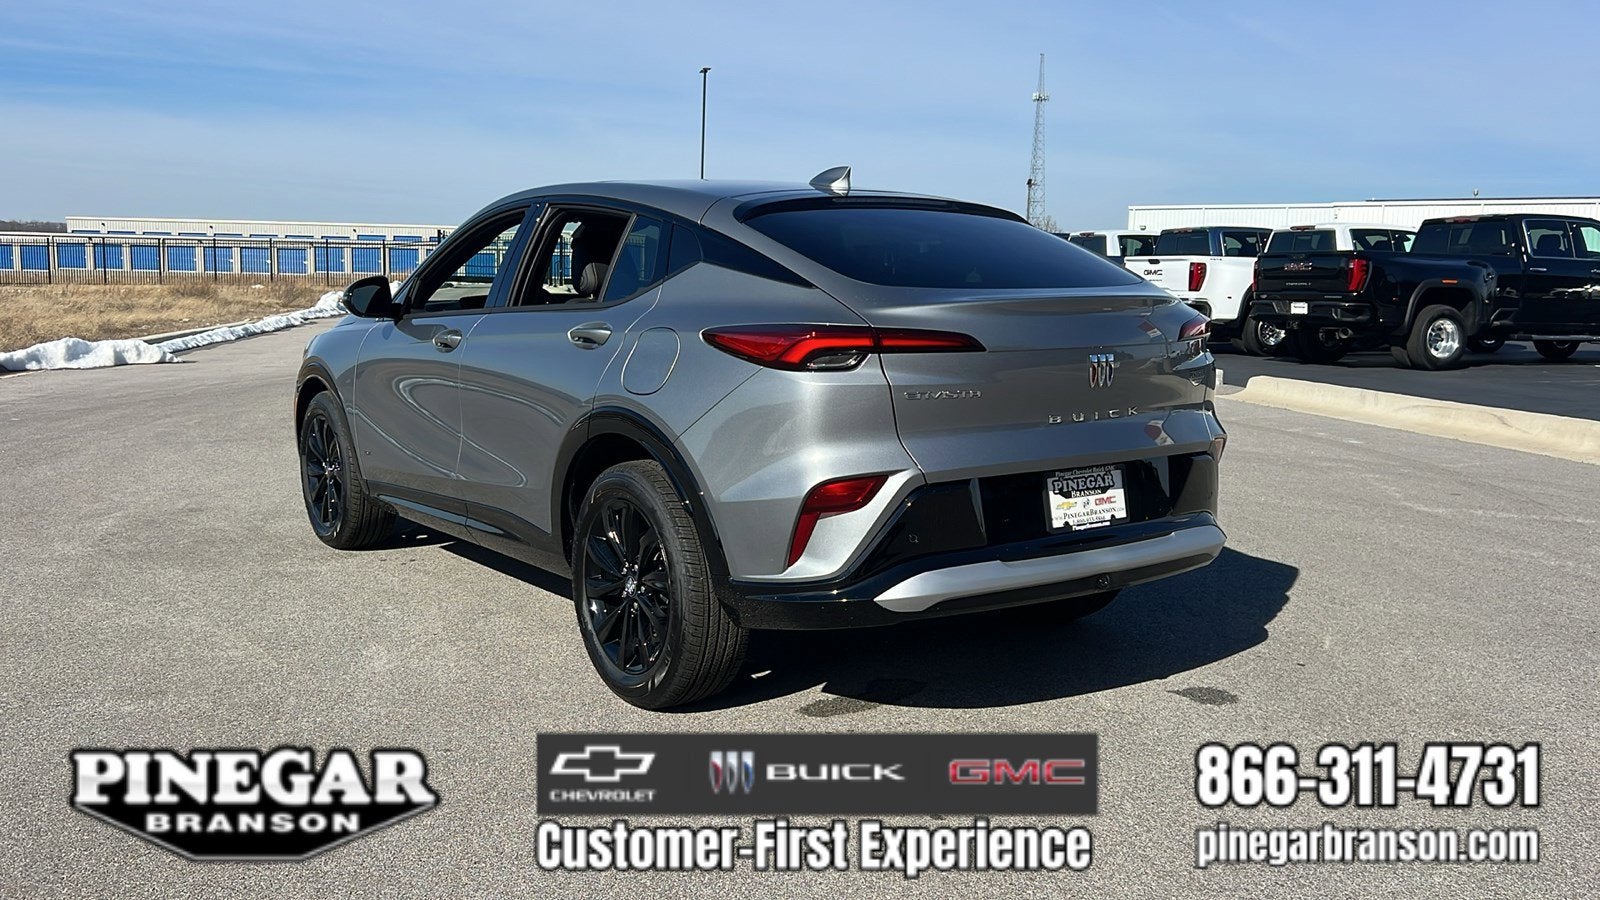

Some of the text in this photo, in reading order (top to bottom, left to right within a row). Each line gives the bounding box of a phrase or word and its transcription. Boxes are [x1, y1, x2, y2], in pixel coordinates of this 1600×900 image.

[1048, 406, 1138, 424] BUICK
[1053, 475, 1114, 493] PINEGAR
[1071, 489, 1102, 499] BRANSON
[1094, 496, 1116, 506] GMC
